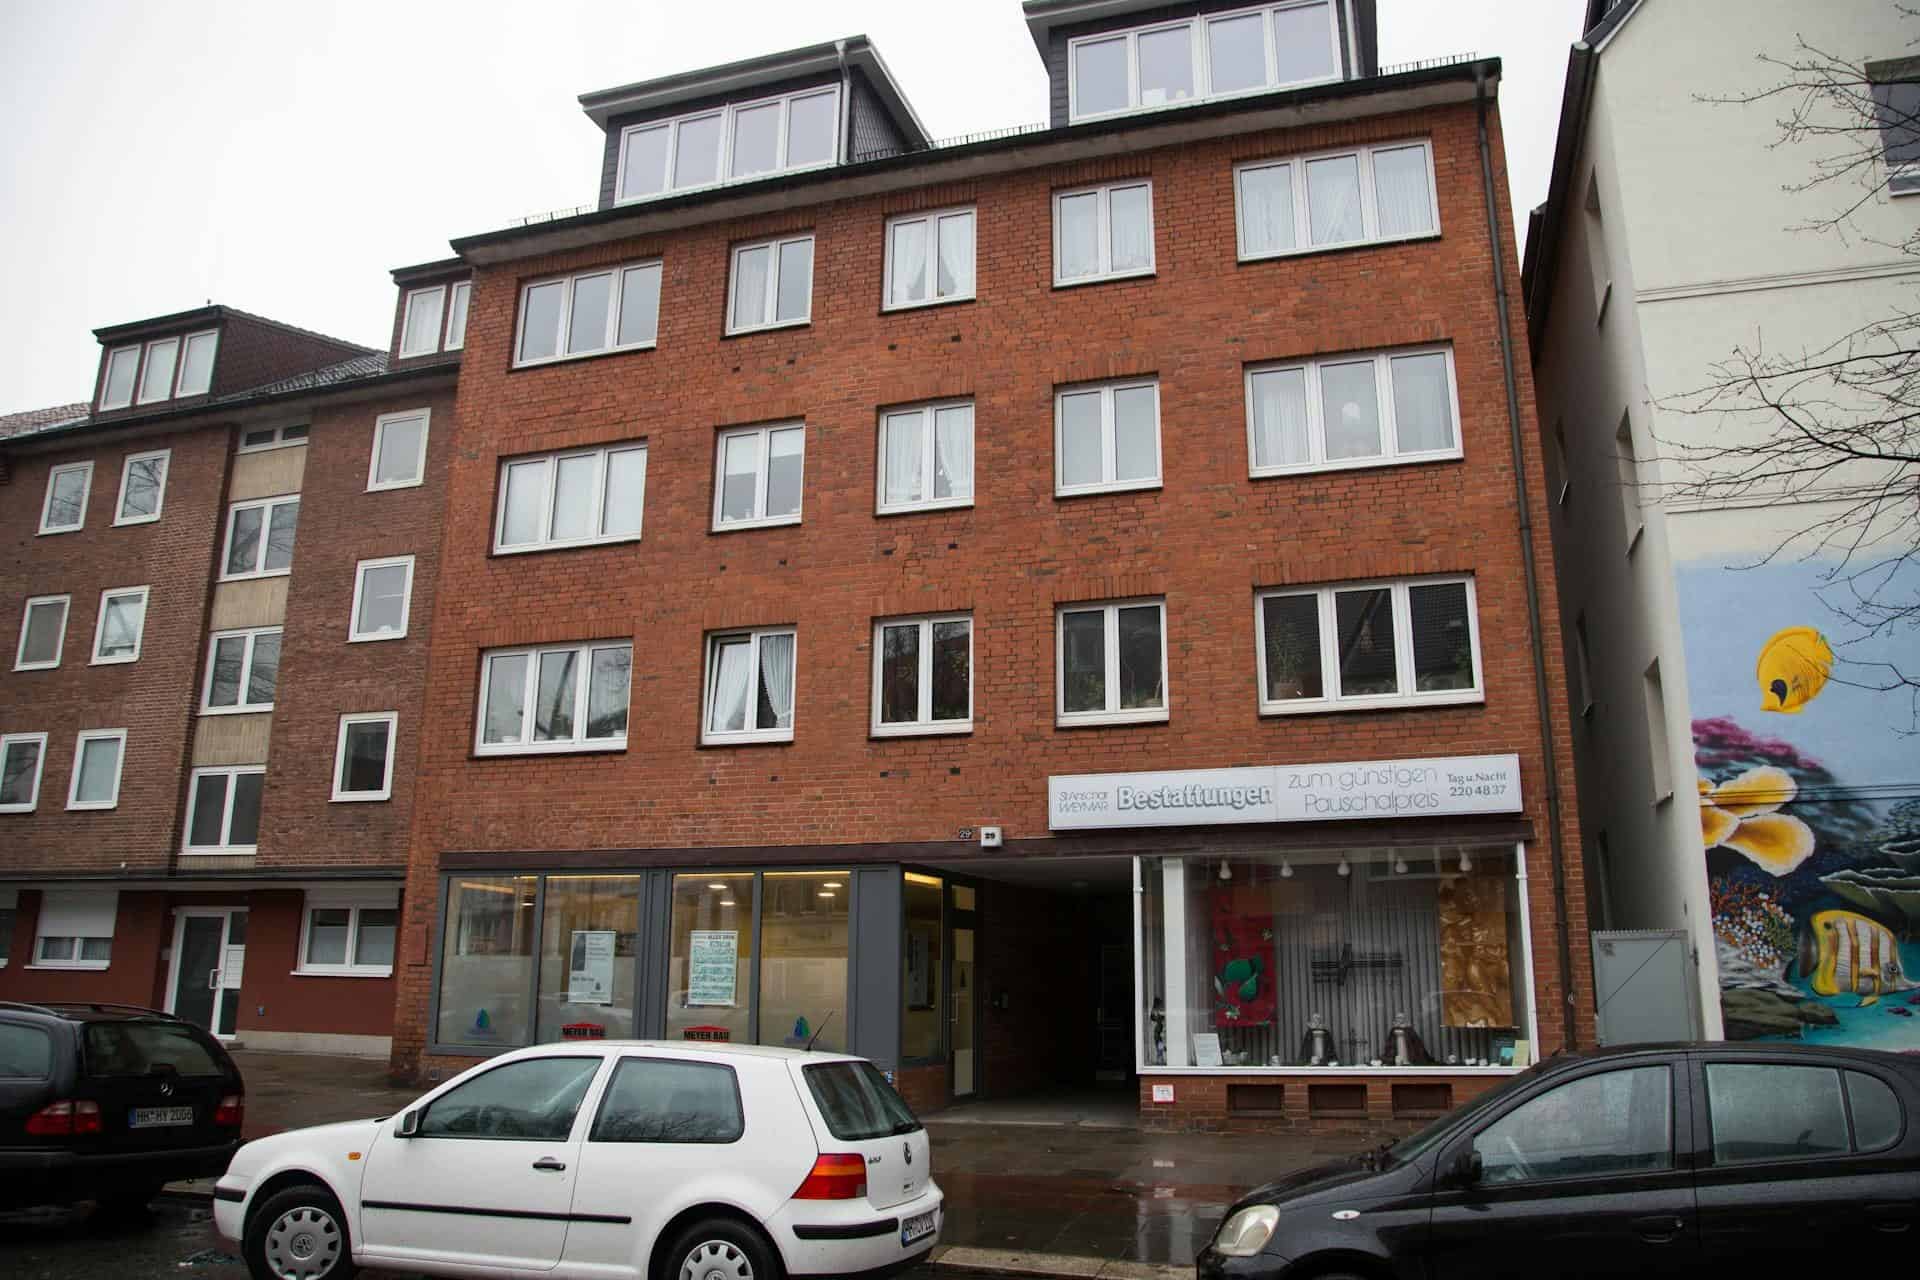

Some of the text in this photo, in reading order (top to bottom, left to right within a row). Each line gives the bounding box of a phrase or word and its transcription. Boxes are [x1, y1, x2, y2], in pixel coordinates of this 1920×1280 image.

[1288, 765, 1438, 791] zum günstigen
[1447, 774, 1465, 785] Tag
[1475, 772, 1507, 781] Nacht
[1449, 784, 1506, 796] 220 48 37
[1117, 784, 1273, 810] Bestattungen
[1304, 790, 1440, 814] Pauschalpreis
[562, 1027, 606, 1036] MEYER BAU
[683, 1031, 729, 1040] MEYER BAU
